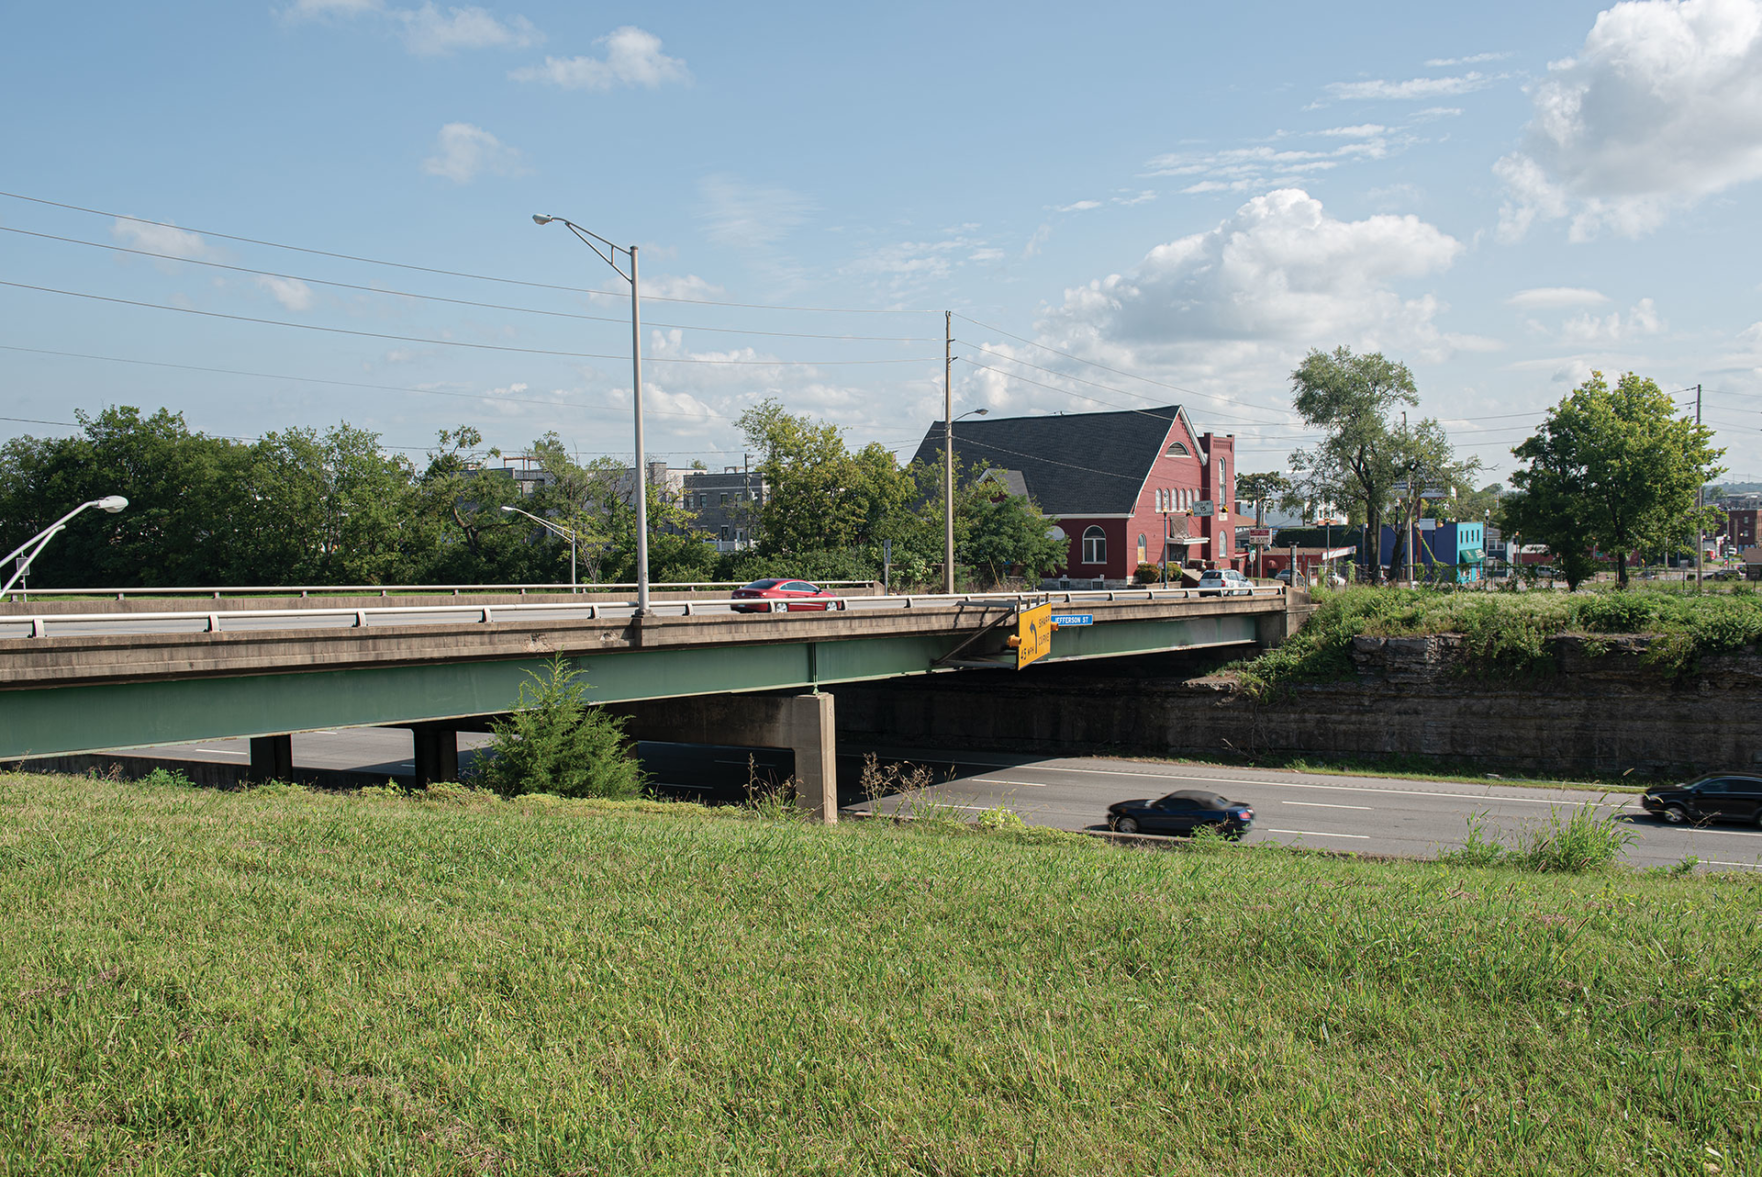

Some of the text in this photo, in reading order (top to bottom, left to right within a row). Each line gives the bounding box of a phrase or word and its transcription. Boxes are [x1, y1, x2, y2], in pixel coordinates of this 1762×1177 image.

[1038, 615, 1050, 628] SHARP
[1055, 616, 1081, 624] JEFFERSON
[1038, 632, 1050, 646] CURVE
[1020, 647, 1027, 660] 45
